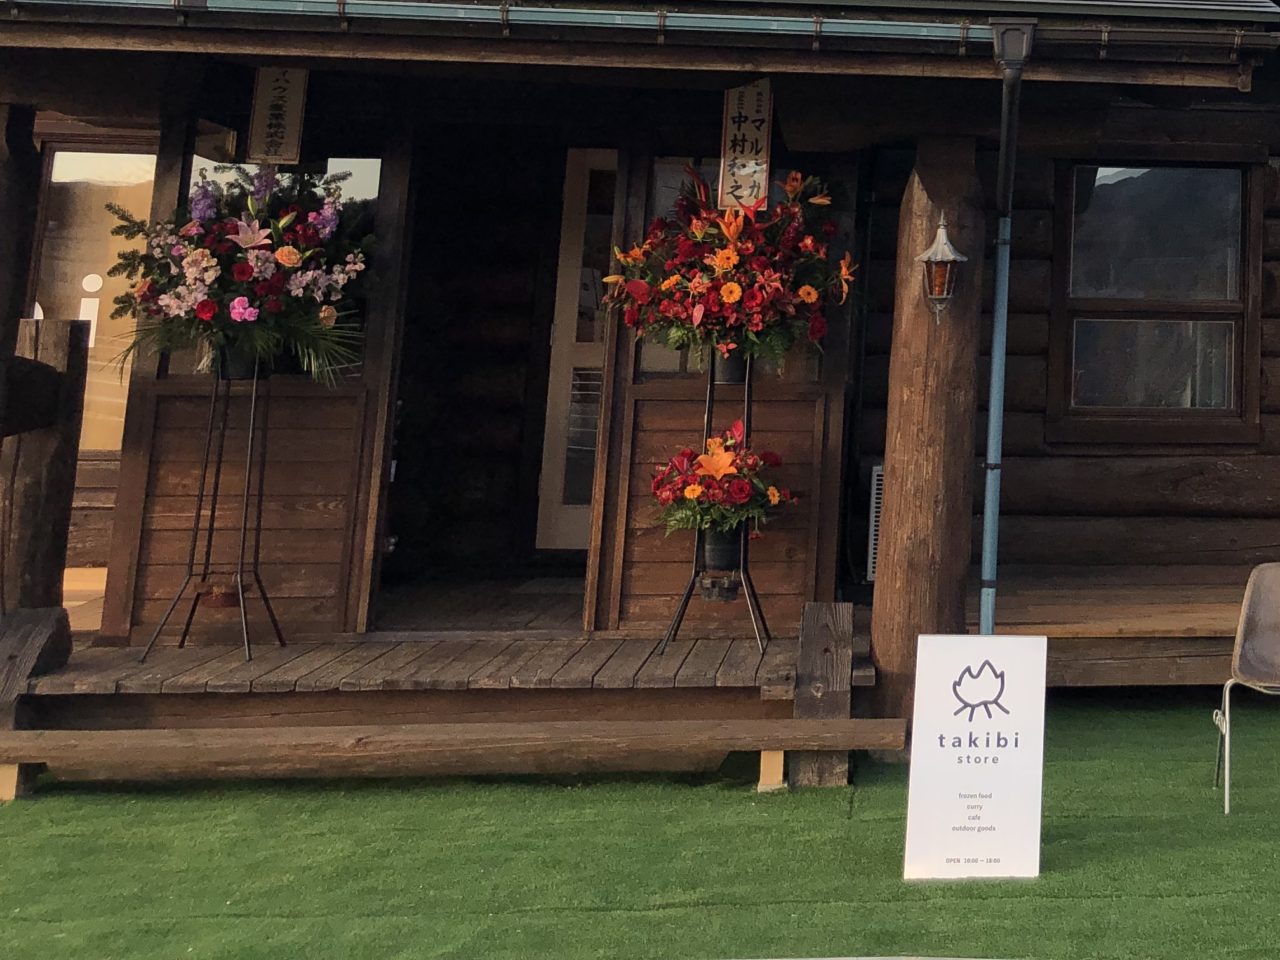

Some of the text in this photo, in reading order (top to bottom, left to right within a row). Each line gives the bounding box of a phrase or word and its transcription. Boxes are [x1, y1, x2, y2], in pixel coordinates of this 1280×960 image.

[937, 731, 1020, 748] takibi
[956, 754, 999, 765] store
[958, 792, 993, 800] frozen food
[966, 803, 984, 811] curry
[951, 824, 996, 833] outdoor goods
